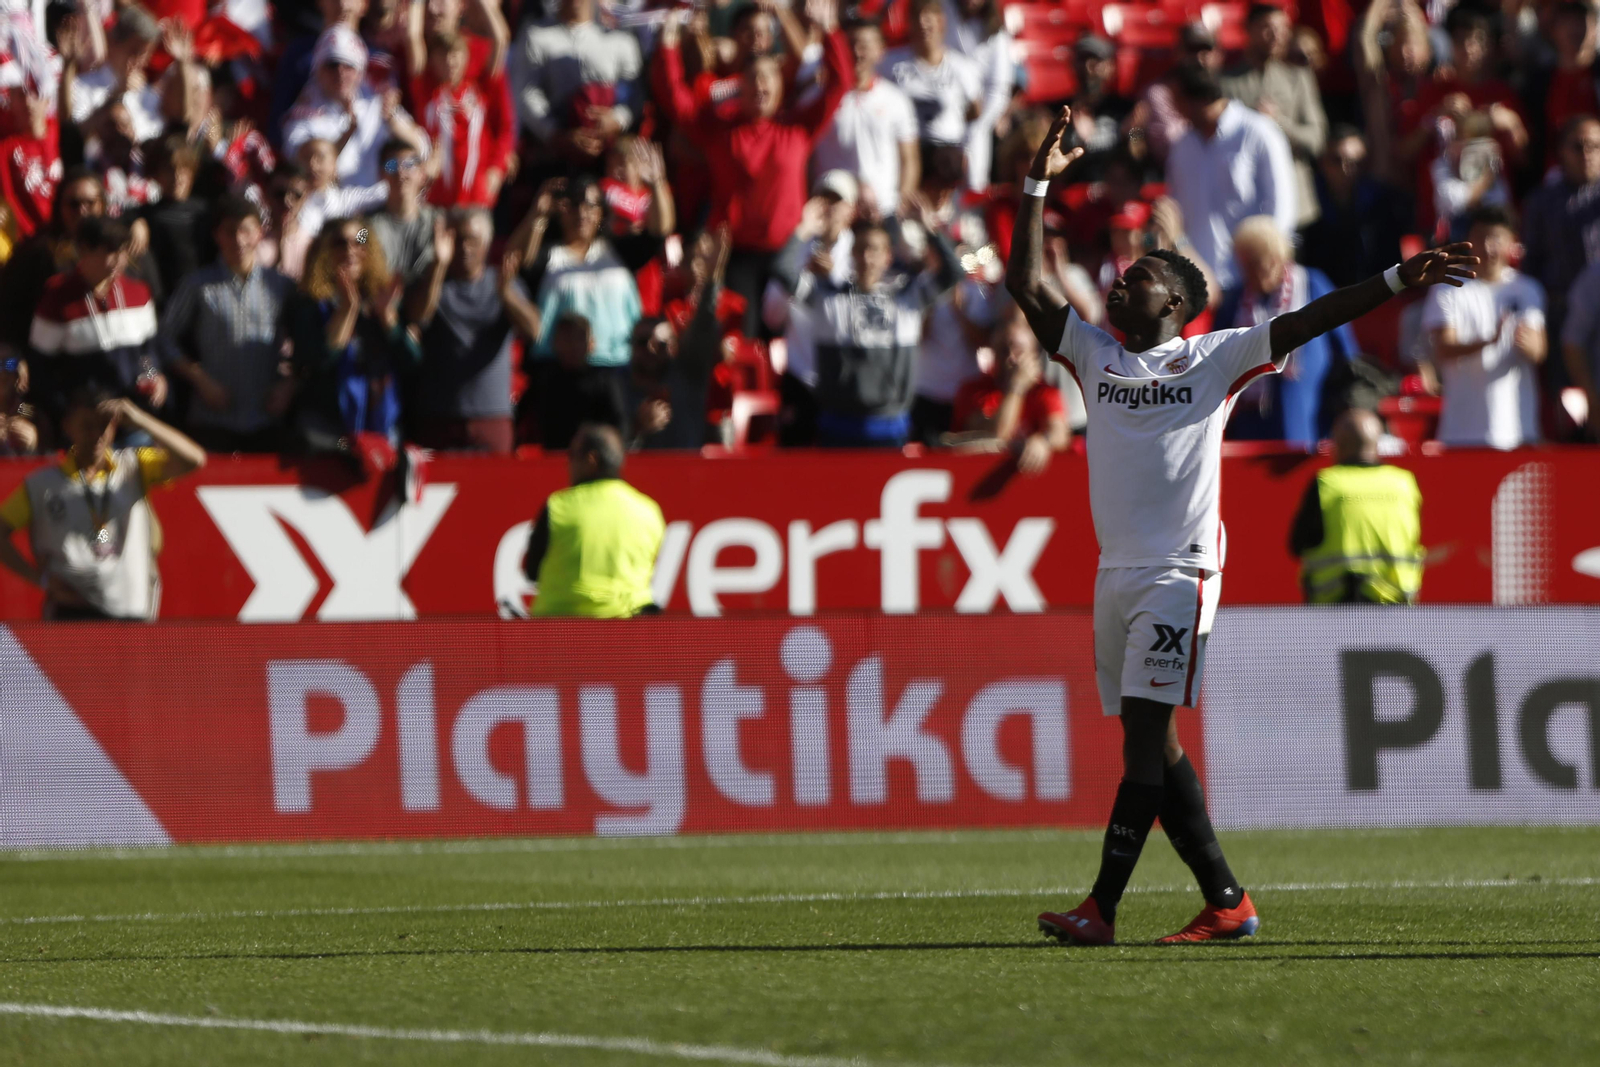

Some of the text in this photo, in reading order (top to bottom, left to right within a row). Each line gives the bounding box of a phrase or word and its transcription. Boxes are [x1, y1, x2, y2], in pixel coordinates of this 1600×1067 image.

[1097, 380, 1192, 409] Playtika
[1144, 656, 1185, 671] everfx
[266, 625, 1072, 837] Playtika
[1112, 823, 1137, 840] SFC
